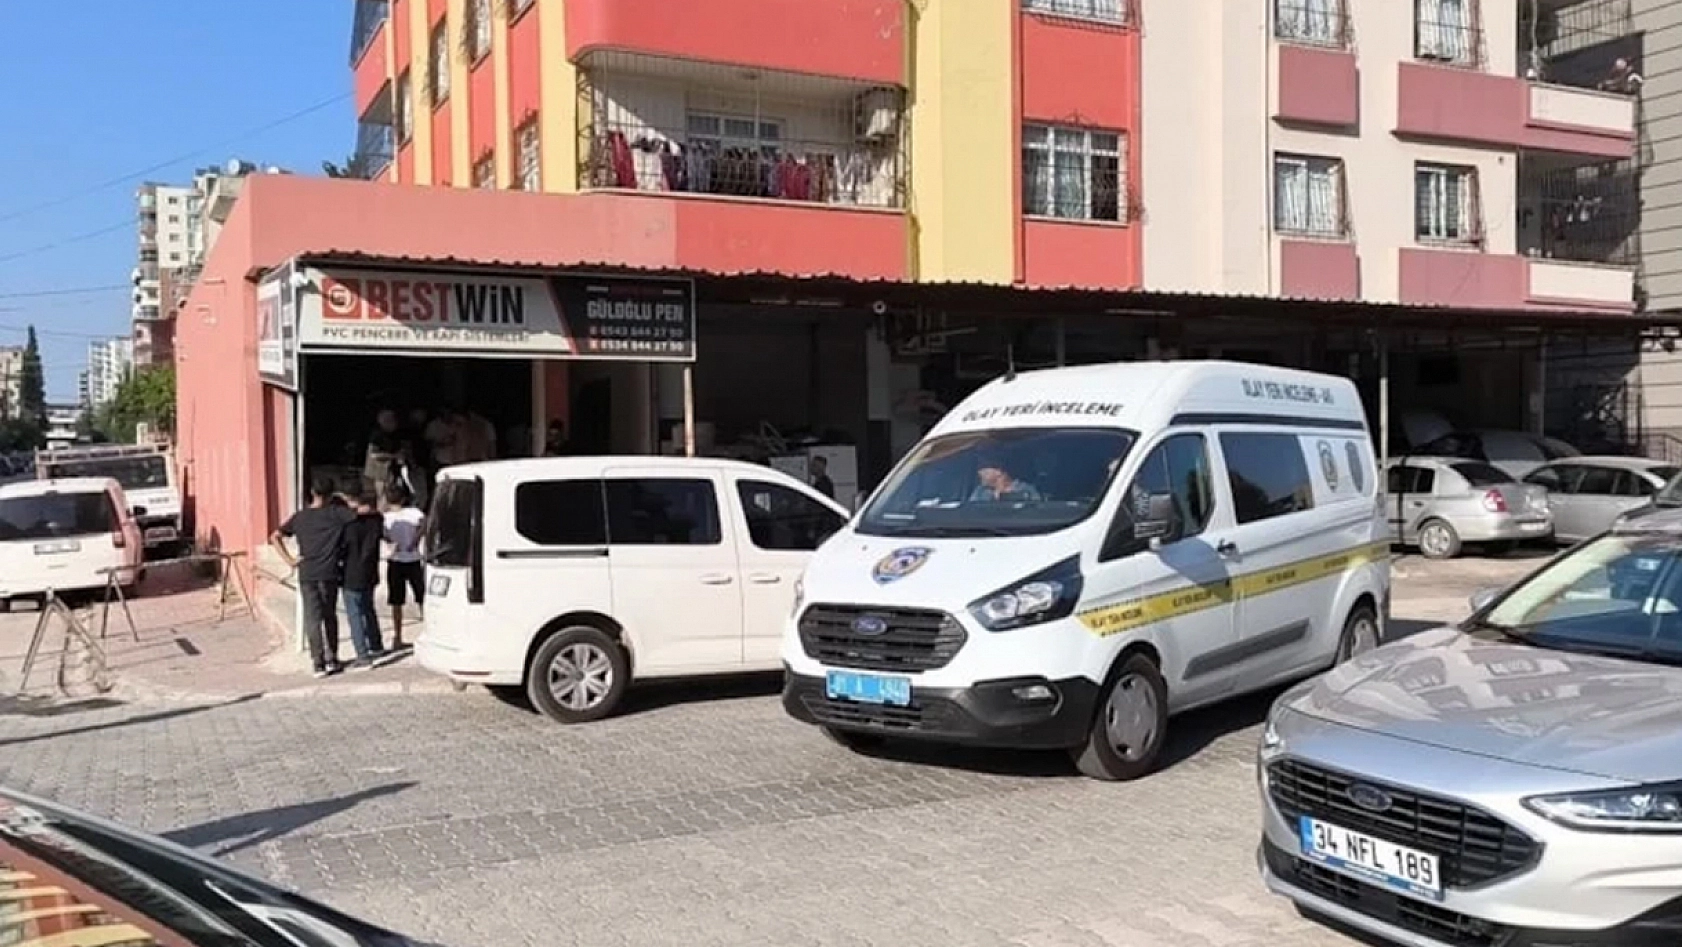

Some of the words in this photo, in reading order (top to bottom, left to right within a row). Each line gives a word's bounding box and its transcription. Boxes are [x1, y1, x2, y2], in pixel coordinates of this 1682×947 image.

[587, 298, 652, 320] GÜLOĞLU
[655, 304, 684, 321] PEN
[322, 326, 348, 338] PVC
[353, 327, 409, 339] PENCERE
[1315, 823, 1338, 853] 34
[1346, 831, 1385, 869] NFL
[1395, 848, 1434, 885] 189
